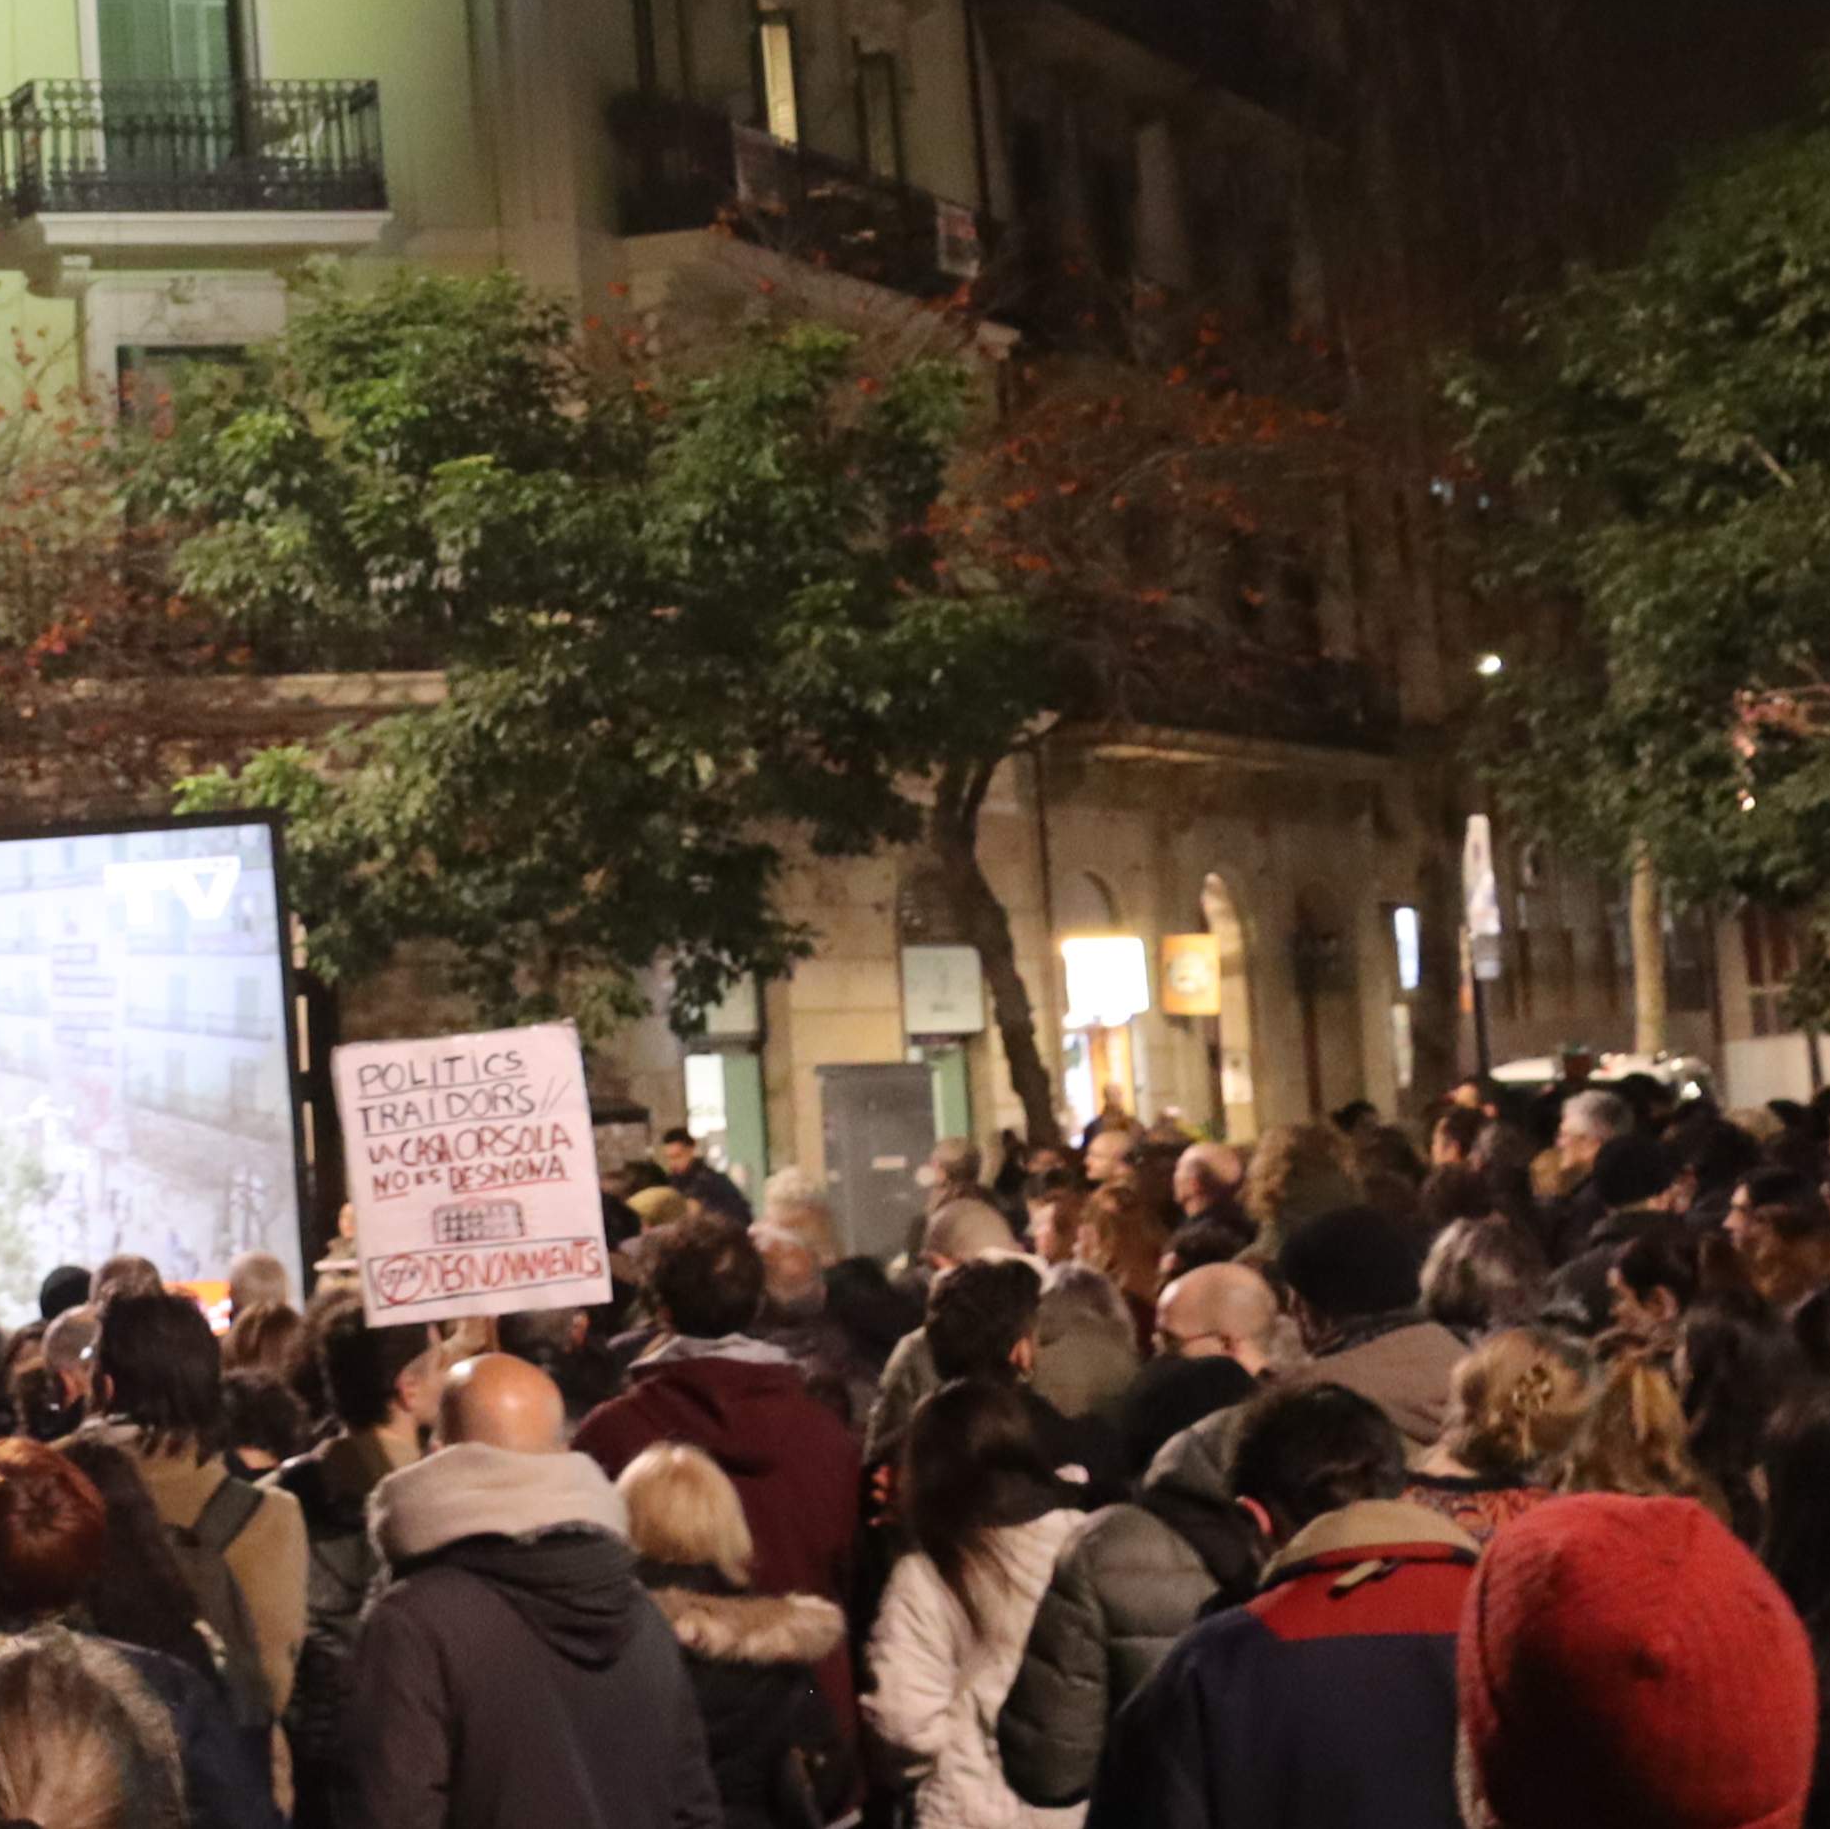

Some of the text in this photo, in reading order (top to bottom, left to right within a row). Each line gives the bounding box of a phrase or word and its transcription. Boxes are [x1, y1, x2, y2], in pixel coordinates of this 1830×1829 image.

[103, 855, 242, 927] TV
[356, 1049, 525, 1093] POLITICS
[356, 1083, 537, 1133] TRAIDORS
[400, 1132, 453, 1167] CASA
[454, 1122, 574, 1161] ORSOLA
[372, 1154, 567, 1194] NO ES DESNONA
[426, 1239, 604, 1295] DESNONAMENTS
